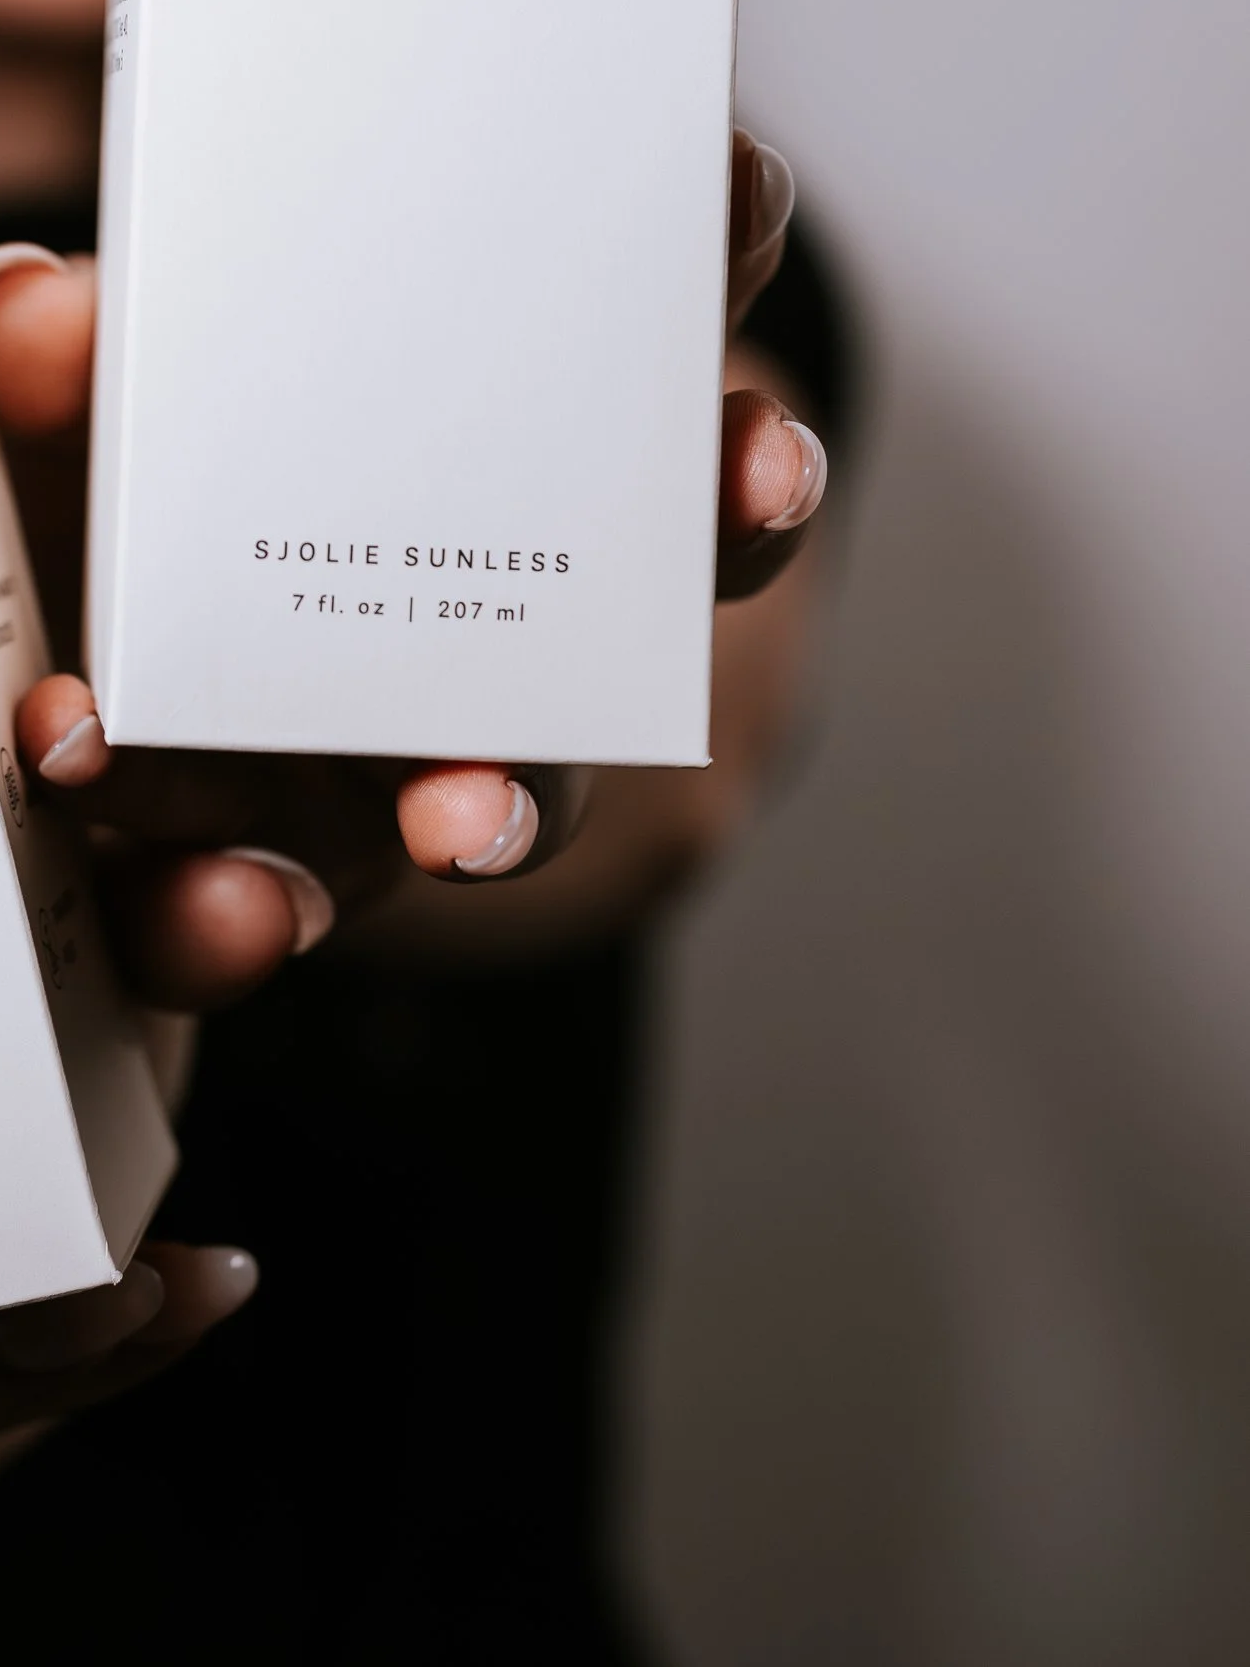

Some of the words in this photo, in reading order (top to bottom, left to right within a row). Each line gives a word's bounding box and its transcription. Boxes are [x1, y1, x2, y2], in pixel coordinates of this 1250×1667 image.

[254, 539, 379, 565] SJOLIE
[404, 546, 570, 574] SUNLESS
[292, 593, 305, 612] 7
[317, 593, 343, 614] fl.
[357, 601, 385, 616] oz
[438, 600, 484, 620] 207
[496, 603, 525, 622] ml
